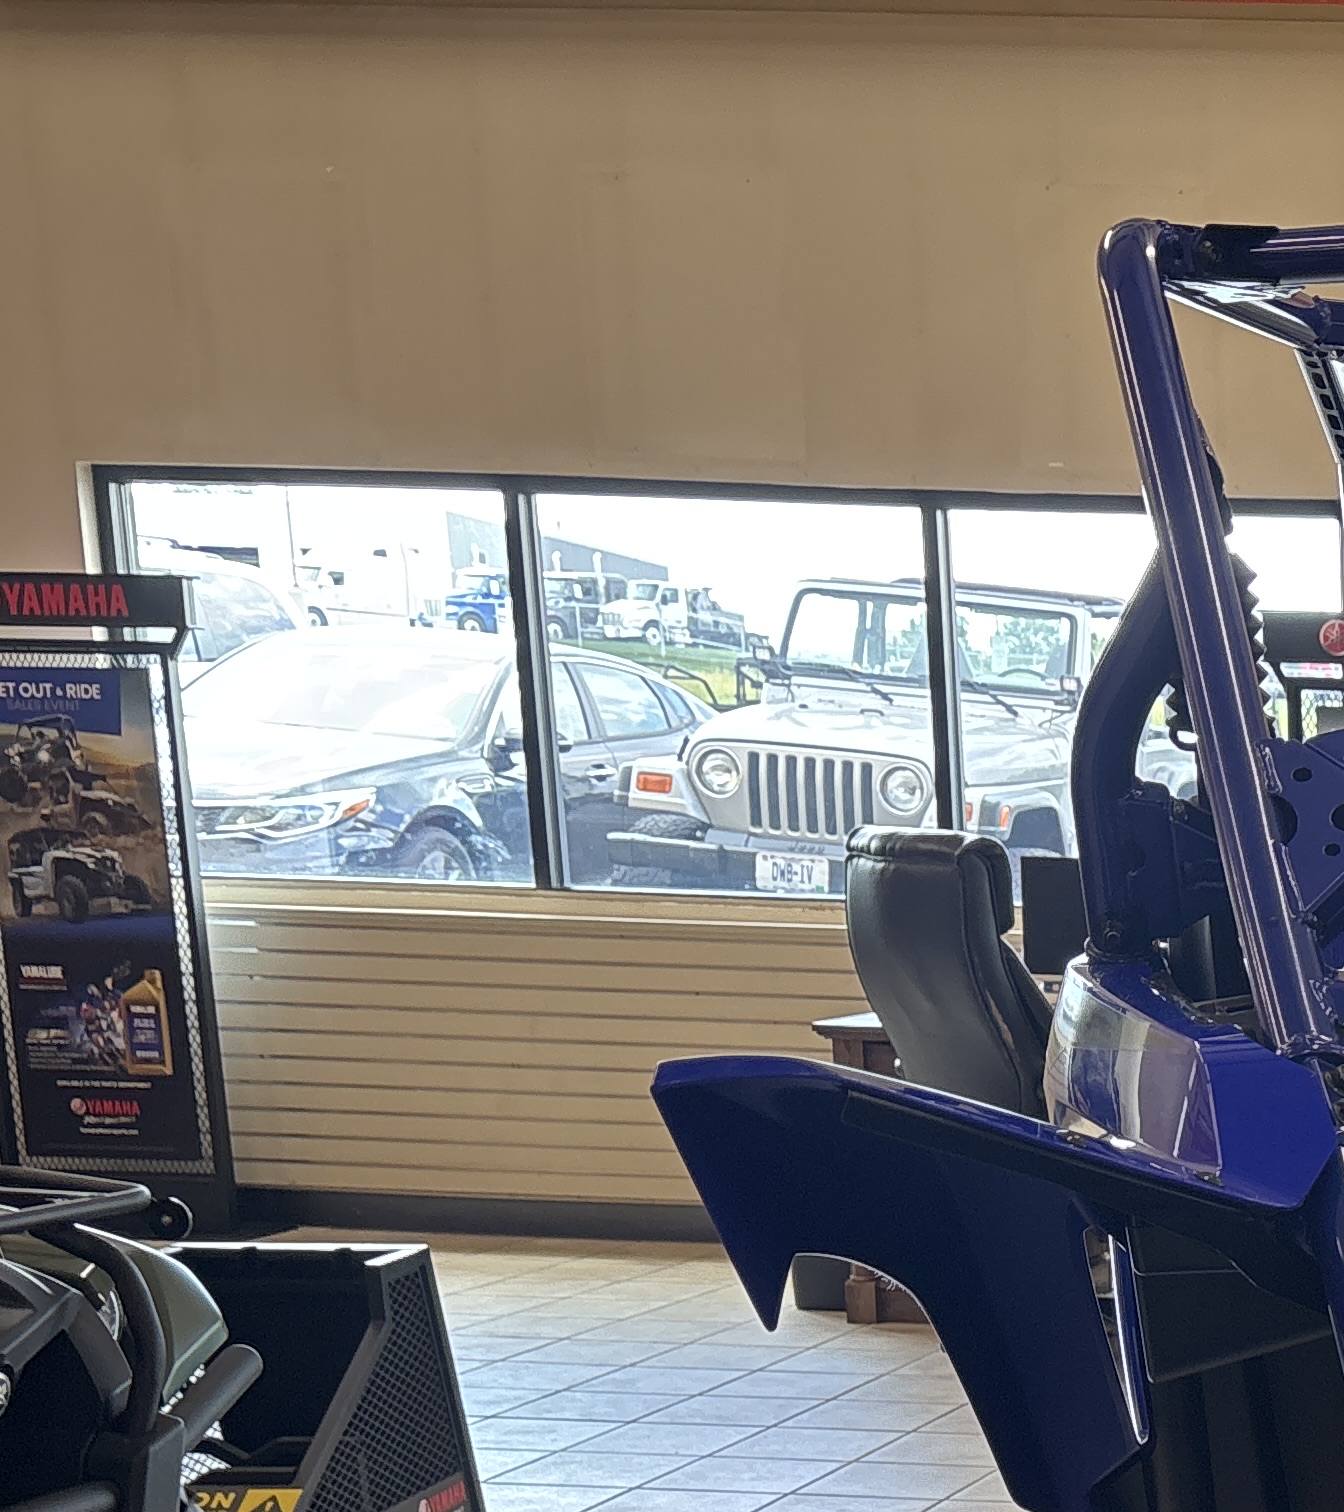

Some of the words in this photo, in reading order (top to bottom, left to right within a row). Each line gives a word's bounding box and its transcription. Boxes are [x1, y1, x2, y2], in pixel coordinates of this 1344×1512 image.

[2, 582, 129, 618] YAMAHA
[18, 682, 53, 699] OUT
[66, 683, 101, 700] RIDE
[86, 1100, 140, 1115] YAMAHA
